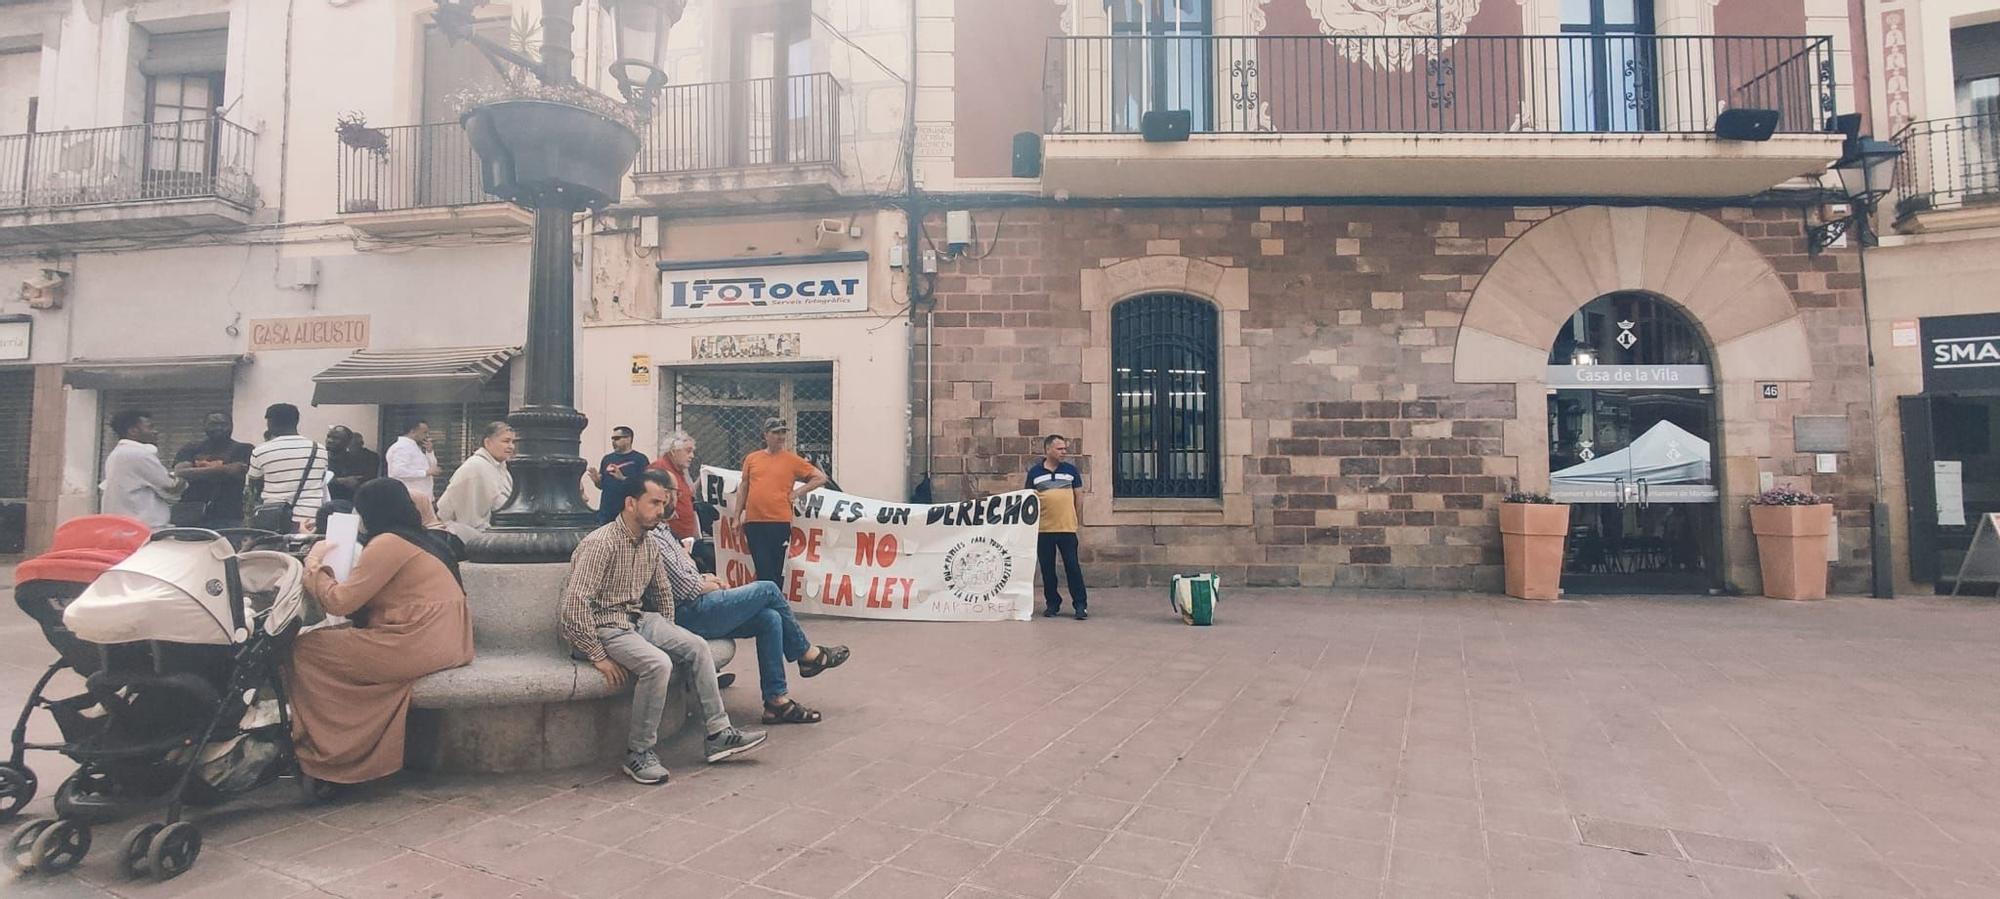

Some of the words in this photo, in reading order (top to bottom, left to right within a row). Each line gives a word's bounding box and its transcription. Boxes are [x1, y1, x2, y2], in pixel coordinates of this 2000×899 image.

[253, 324, 292, 345] CASA
[294, 320, 365, 343] AUGUSTO
[1934, 342, 2000, 363] SMA
[1576, 368, 1610, 382] Casa
[1614, 368, 1633, 382] de
[1635, 368, 1649, 382] la
[1650, 368, 1680, 382] Vila
[1764, 385, 1778, 397] 46
[707, 474, 727, 508] EL
[829, 499, 864, 523] ES
[876, 506, 911, 526] UN
[926, 494, 1039, 526] DERECHO
[854, 531, 898, 568] NO
[822, 573, 854, 607] LA
[866, 576, 915, 609] LEY
